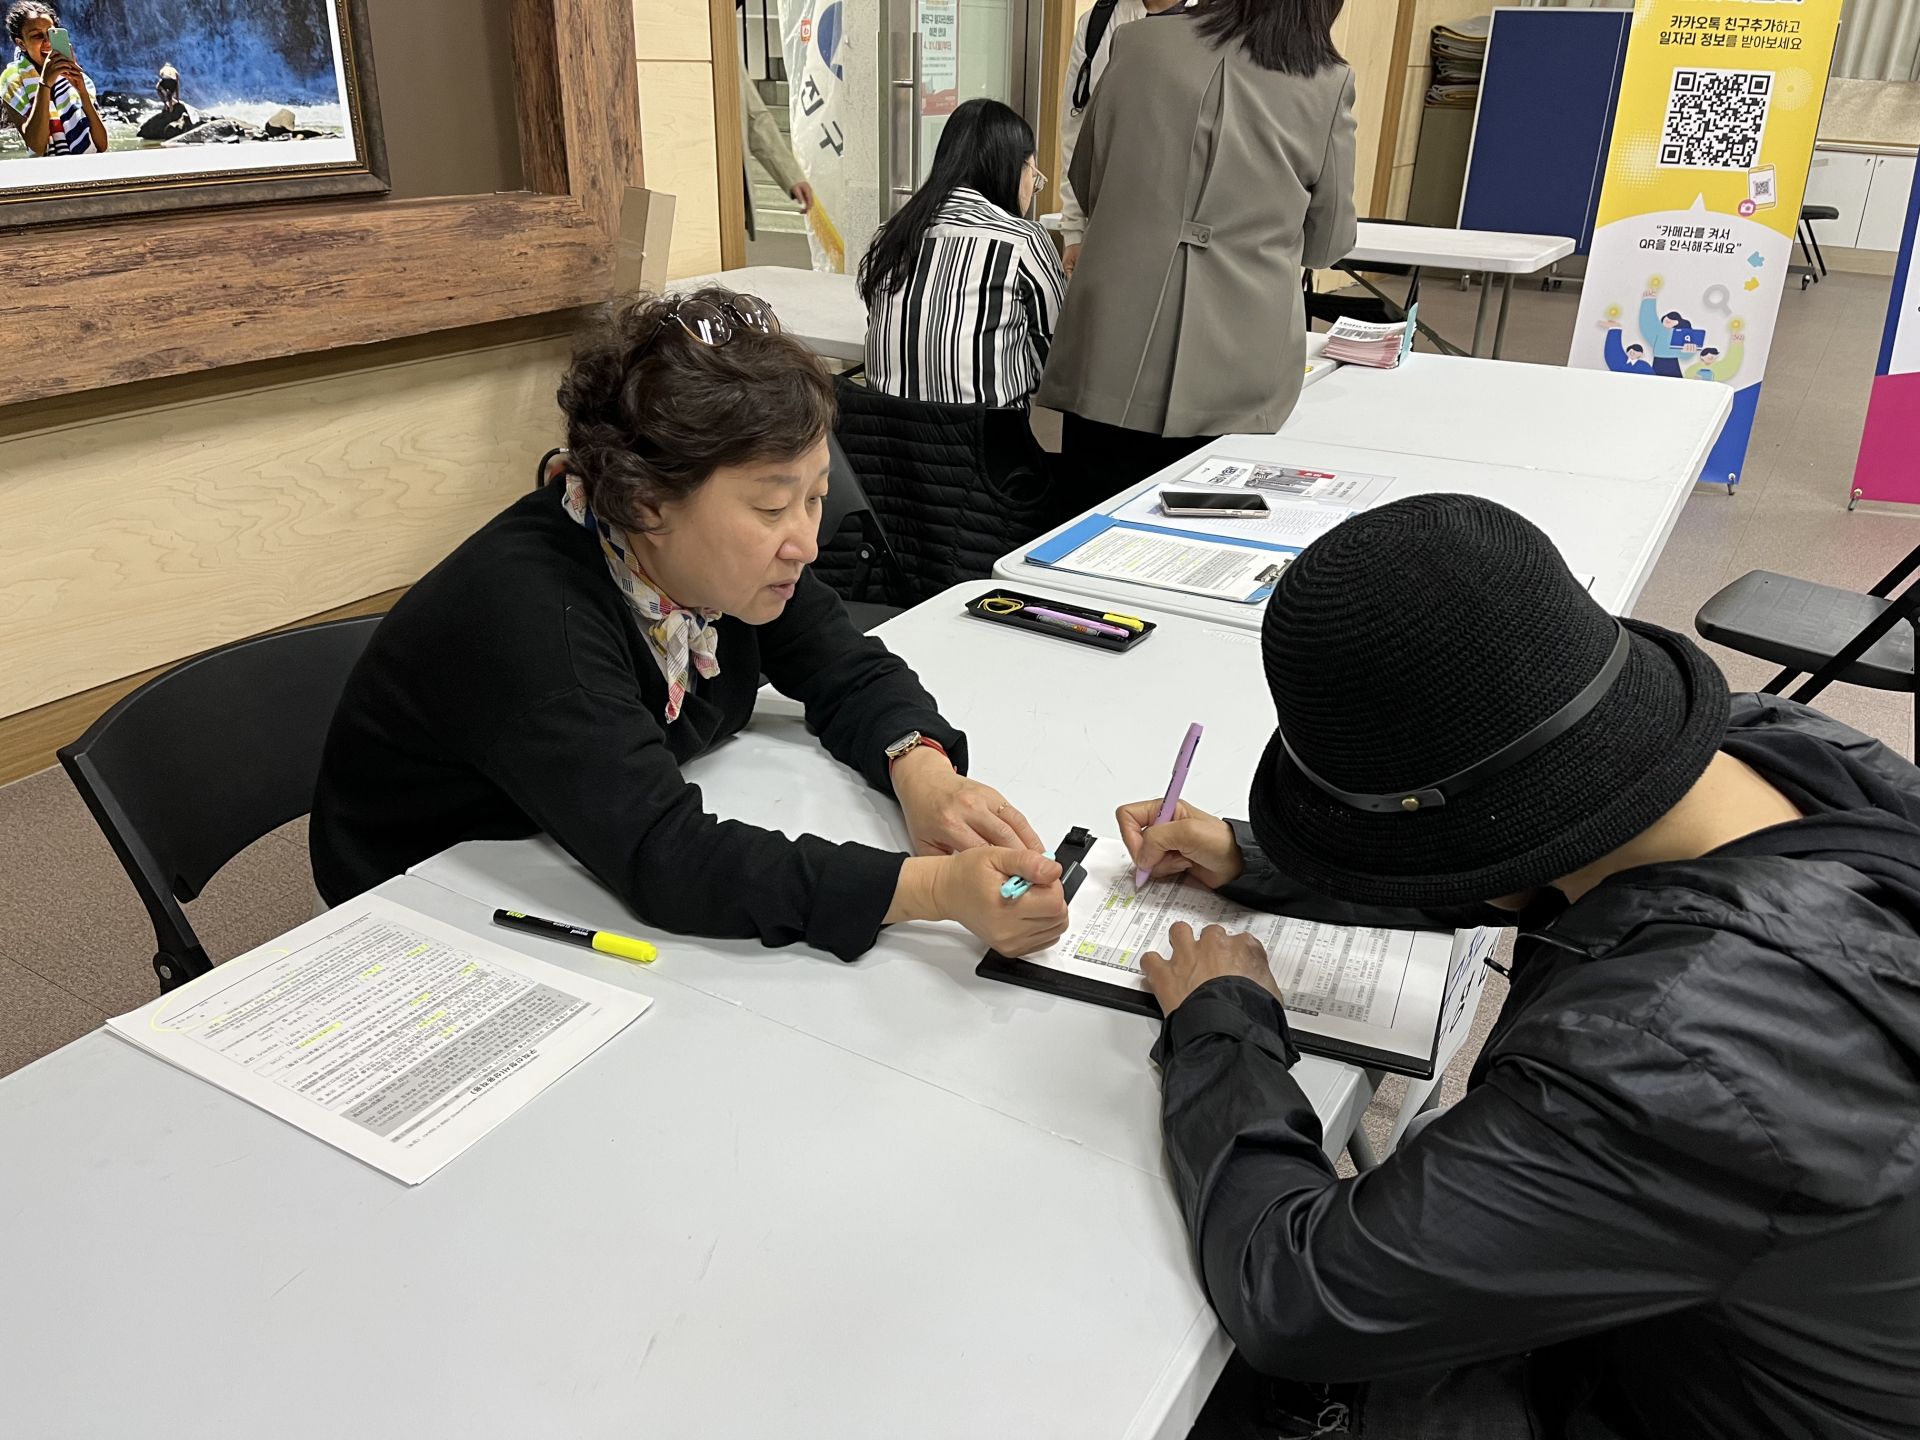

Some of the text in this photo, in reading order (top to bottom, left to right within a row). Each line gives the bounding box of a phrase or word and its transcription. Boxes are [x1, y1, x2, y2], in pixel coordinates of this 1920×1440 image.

[1670, 15, 1801, 34] 카카오톡 친구추가하고
[1659, 31, 1803, 50] 일자리 정보를 받아보세요
[1707, 227, 1731, 240] 켜서
[1639, 238, 1742, 254] QR을 인식해주세요”
